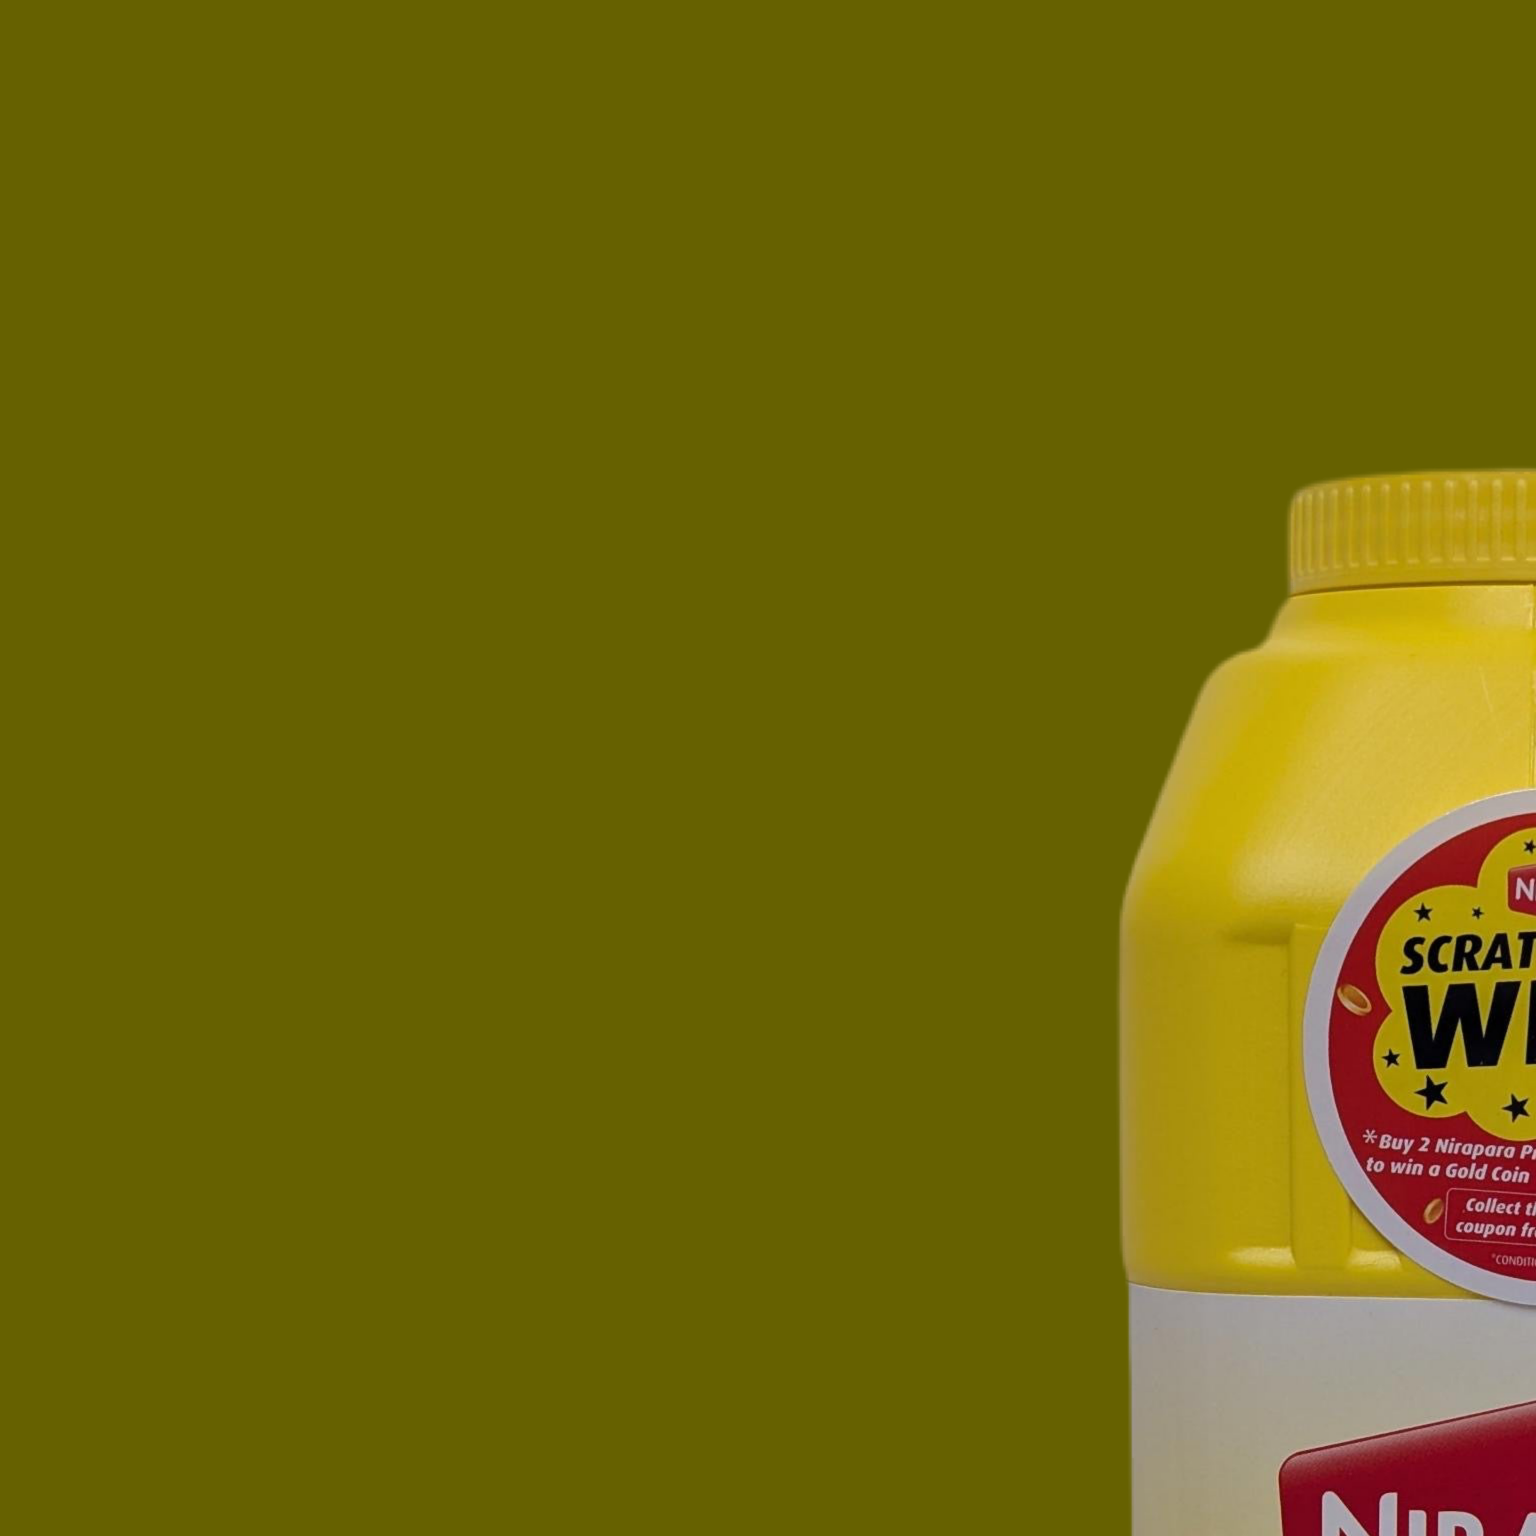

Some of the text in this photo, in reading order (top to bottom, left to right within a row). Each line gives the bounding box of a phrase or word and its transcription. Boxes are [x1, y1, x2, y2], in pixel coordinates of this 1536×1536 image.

[1419, 1136, 1430, 1153] 2
[1435, 1138, 1516, 1163] Nirapara
[1366, 1157, 1385, 1173] to
[1390, 1159, 1424, 1175] win
[1428, 1164, 1440, 1177] a
[1445, 1163, 1485, 1181] Gold
[1491, 1166, 1530, 1184] Coin
[1465, 1198, 1521, 1217] Collect
[1455, 1220, 1517, 1241] coupon
